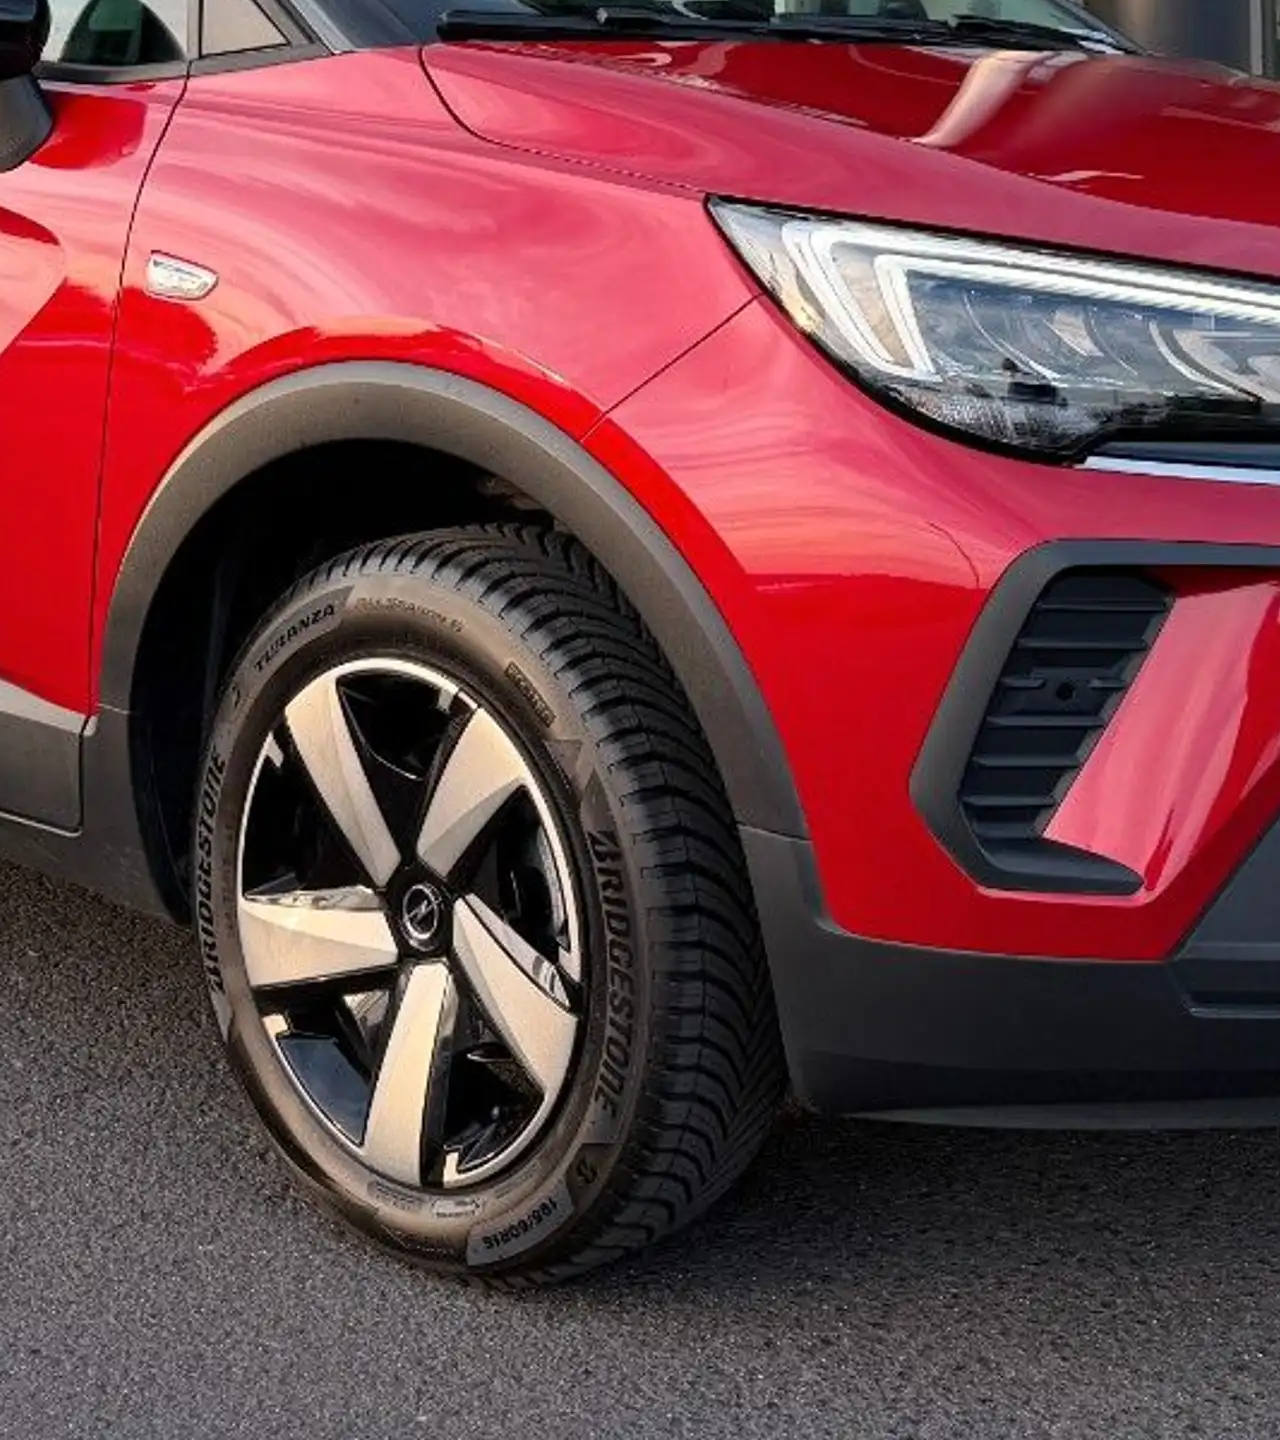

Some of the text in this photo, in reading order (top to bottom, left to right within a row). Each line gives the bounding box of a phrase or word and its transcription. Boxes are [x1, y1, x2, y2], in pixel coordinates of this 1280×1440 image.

[253, 603, 336, 673] TURANZA
[195, 752, 227, 995] BRIDGESTONE
[585, 830, 635, 1119] BRIDGESTONE
